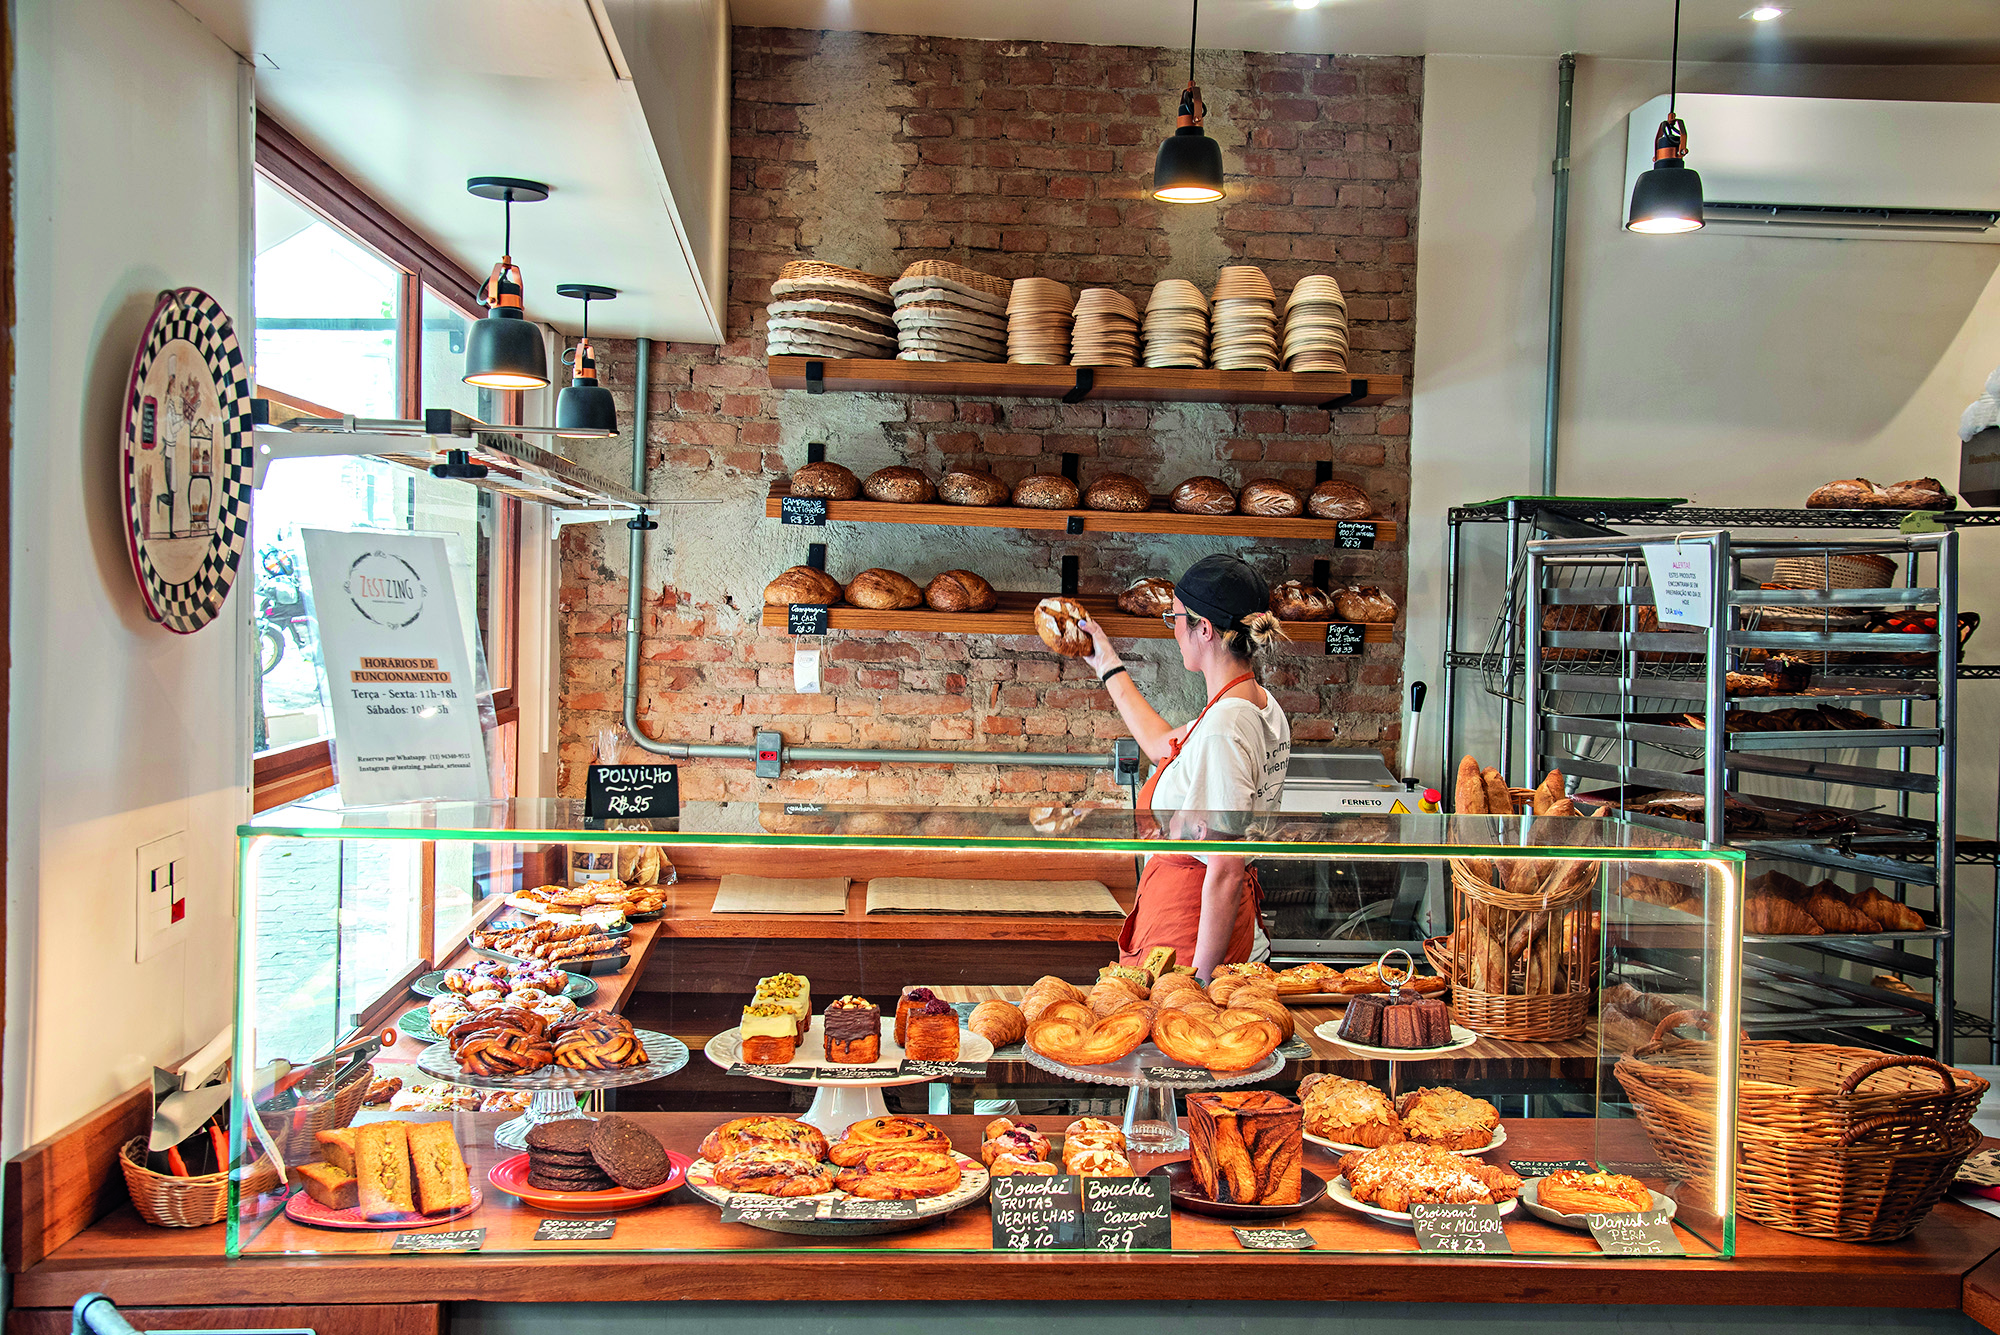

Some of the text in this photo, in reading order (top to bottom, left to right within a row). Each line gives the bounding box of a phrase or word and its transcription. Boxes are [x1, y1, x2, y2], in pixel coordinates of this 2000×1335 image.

[365, 657, 435, 669] HORÁRIOS DE
[354, 671, 448, 682] FUNCIONAMENTO
[351, 688, 380, 700] Terça
[388, 689, 418, 699] Sexta:
[419, 688, 458, 699] 11h-18h
[366, 705, 409, 715] Sábados:
[1088, 1177, 1155, 1199] Bouchée
[1000, 1197, 1053, 1210] FRUTAS
[1092, 1200, 1117, 1212] au
[1414, 1204, 1477, 1219] Croissant
[1418, 1218, 1437, 1231] PÉ
[1454, 1218, 1504, 1234] MOLEQUE
[1589, 1212, 1669, 1230] Danish de
[403, 1229, 480, 1242] FINANCIER
[1007, 1232, 1054, 1251] R$ 10
[1097, 1230, 1134, 1252] R$ 9
[1436, 1238, 1486, 1252] R$ 23
